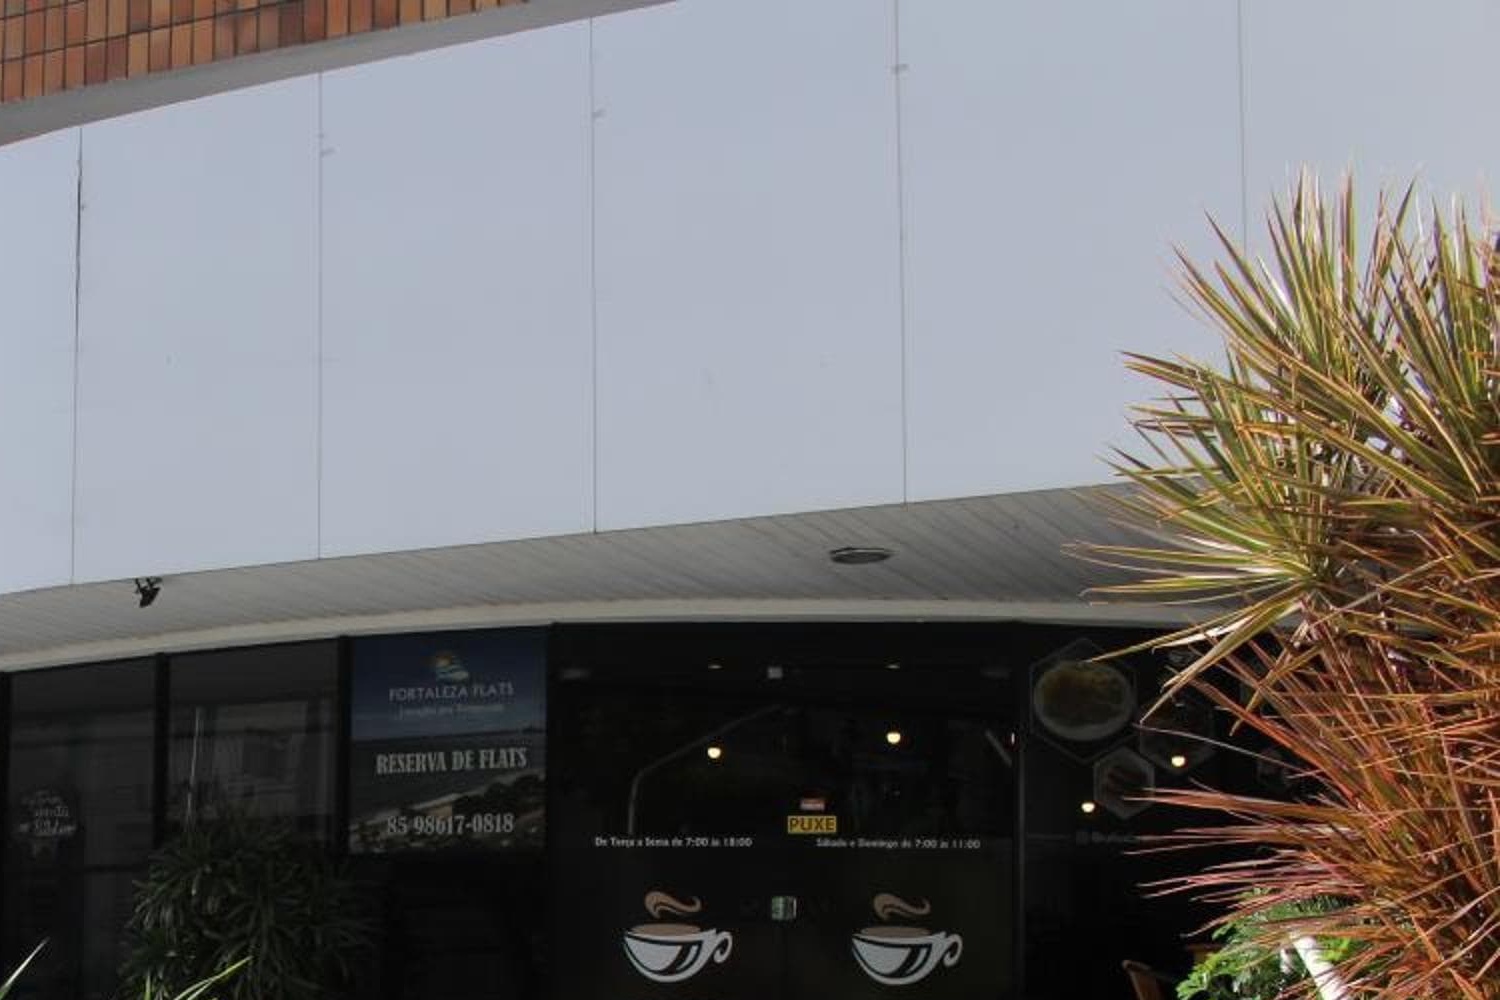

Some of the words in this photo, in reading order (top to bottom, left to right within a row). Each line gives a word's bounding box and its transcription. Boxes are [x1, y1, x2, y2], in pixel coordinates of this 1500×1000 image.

[389, 687, 468, 701] FORTALEZA
[472, 681, 514, 697] FLATS
[376, 752, 446, 775] RESERVA
[452, 750, 475, 770] DE
[480, 748, 528, 769] FLATS
[387, 816, 406, 835] 85
[789, 817, 836, 831] PUXE
[685, 837, 709, 847] 7:00
[915, 839, 937, 848] 7:00
